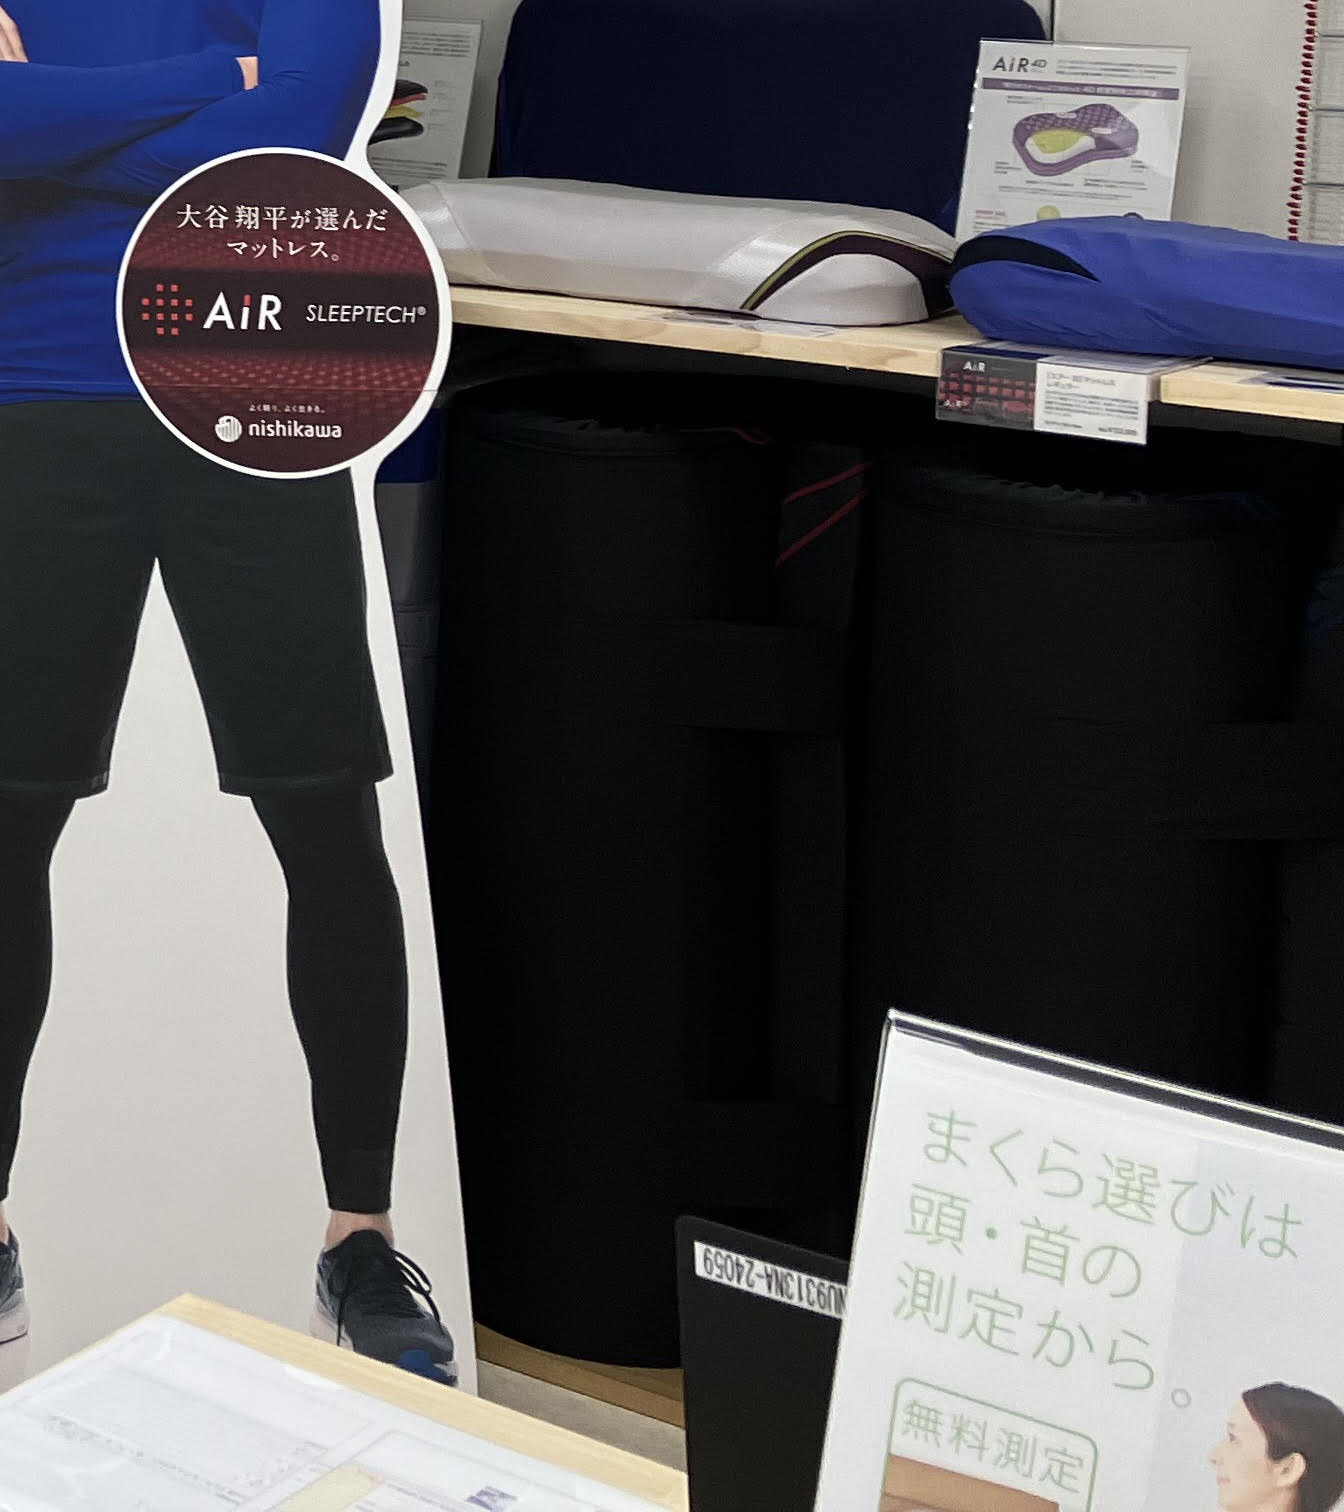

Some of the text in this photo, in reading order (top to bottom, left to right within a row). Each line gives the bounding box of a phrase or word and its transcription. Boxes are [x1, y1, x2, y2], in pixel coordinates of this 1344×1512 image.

[176, 203, 389, 232] 大谷翔平が選んだ
[226, 237, 340, 262] マットレス。
[248, 417, 343, 439] nishikawa
[922, 1110, 1303, 1260] まくら選びは
[903, 1182, 1143, 1299] 頭・首の
[893, 1260, 1193, 1410] 測定から。
[902, 1399, 1084, 1494] 無料測定
